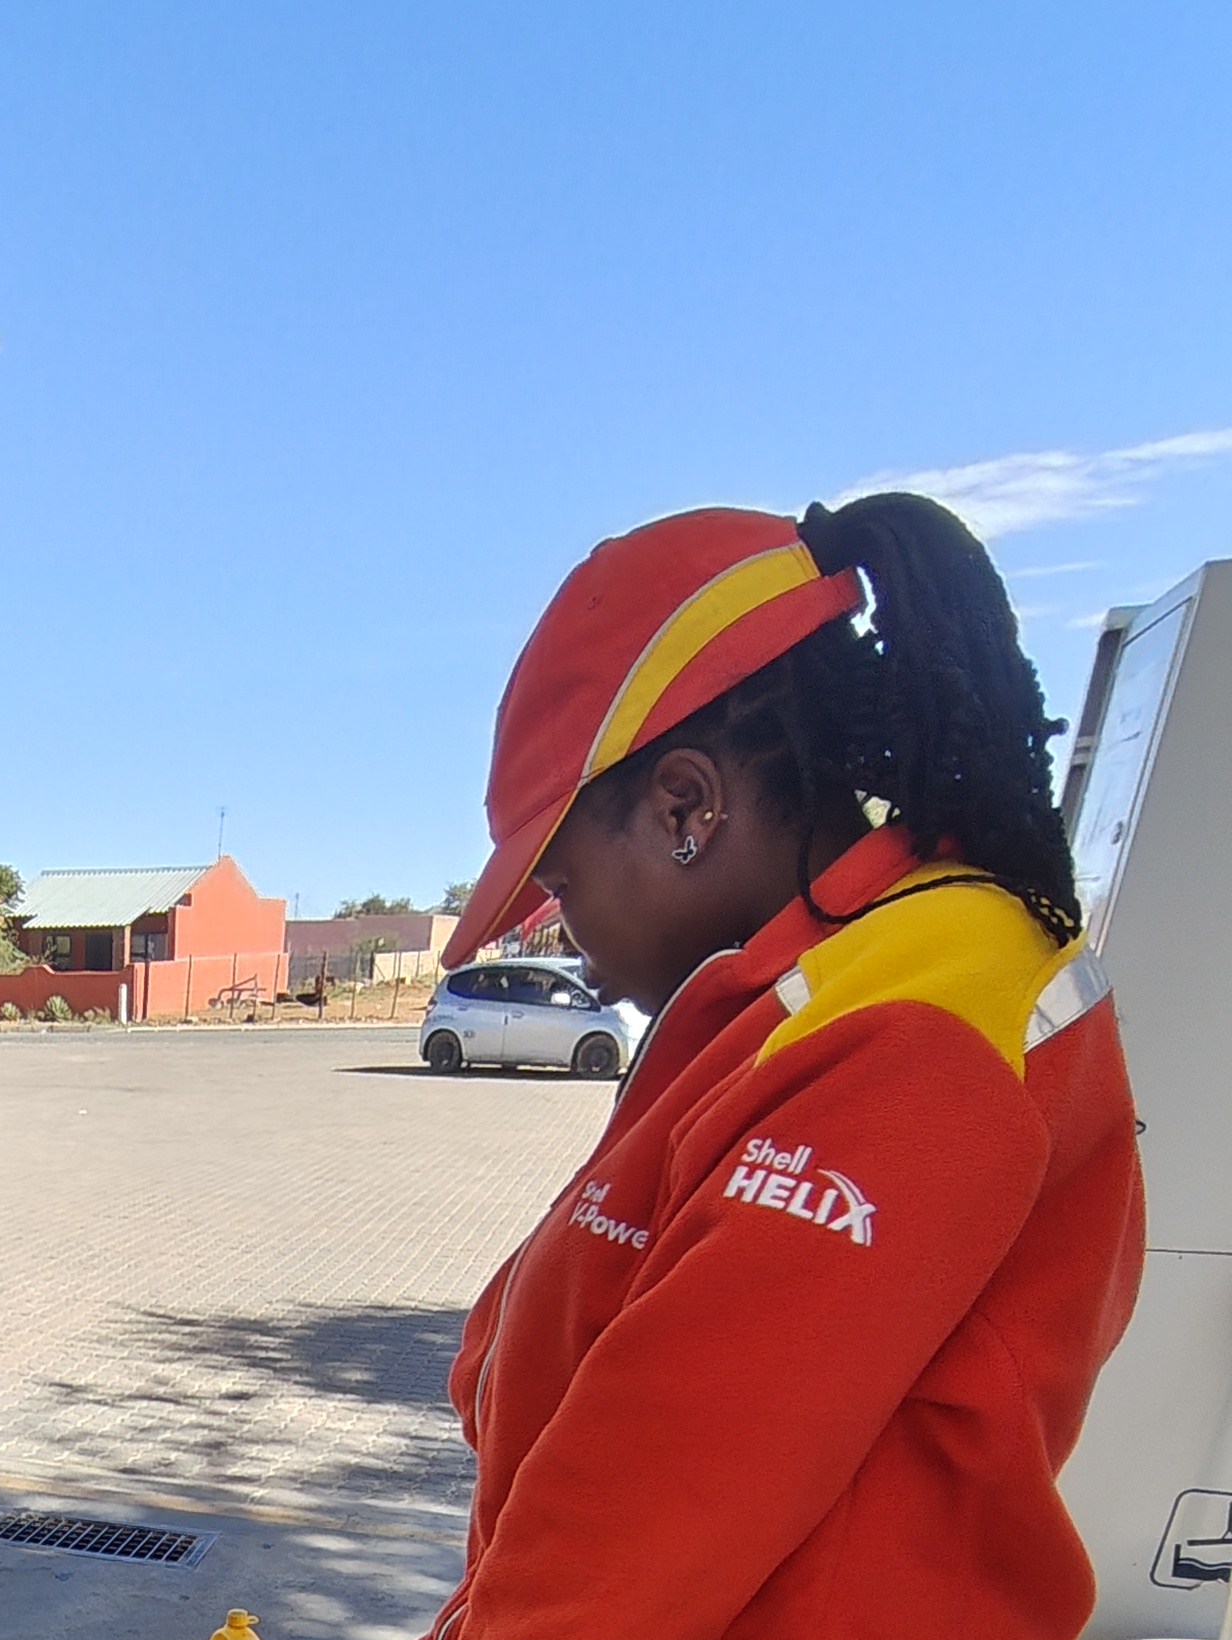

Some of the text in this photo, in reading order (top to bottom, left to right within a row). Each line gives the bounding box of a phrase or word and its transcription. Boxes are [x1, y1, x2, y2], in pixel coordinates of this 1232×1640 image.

[741, 1138, 812, 1173] Shell
[568, 1202, 649, 1249] V-Powe
[723, 1166, 876, 1246] HELIX
